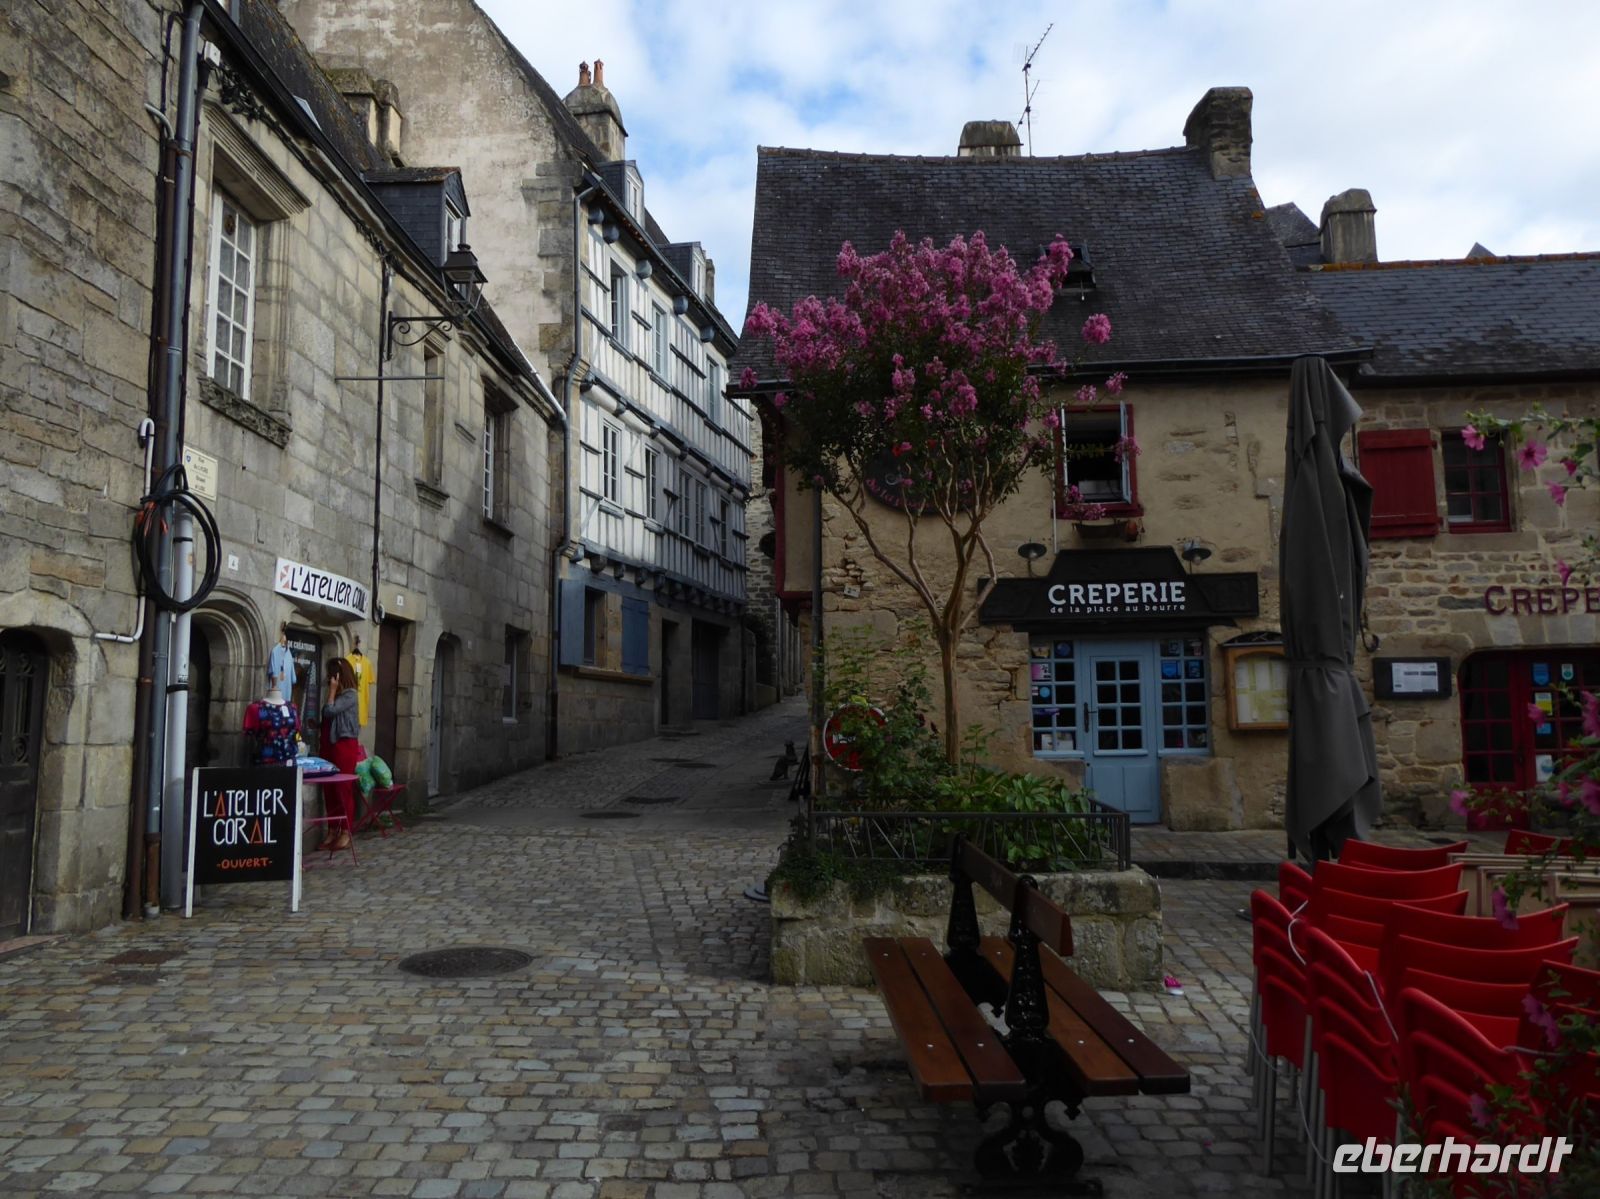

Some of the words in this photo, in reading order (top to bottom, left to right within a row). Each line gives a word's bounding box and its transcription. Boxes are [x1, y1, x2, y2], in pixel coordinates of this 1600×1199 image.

[290, 566, 352, 606] L'ATELIER
[1048, 581, 1186, 606] CREPERIE
[1050, 605, 1064, 614] de
[1069, 605, 1081, 613] la
[1086, 605, 1119, 614] place
[1125, 604, 1139, 612] au
[1144, 603, 1185, 612] beurre
[203, 788, 289, 818] L'ATELIER
[213, 817, 278, 845] CORAIL
